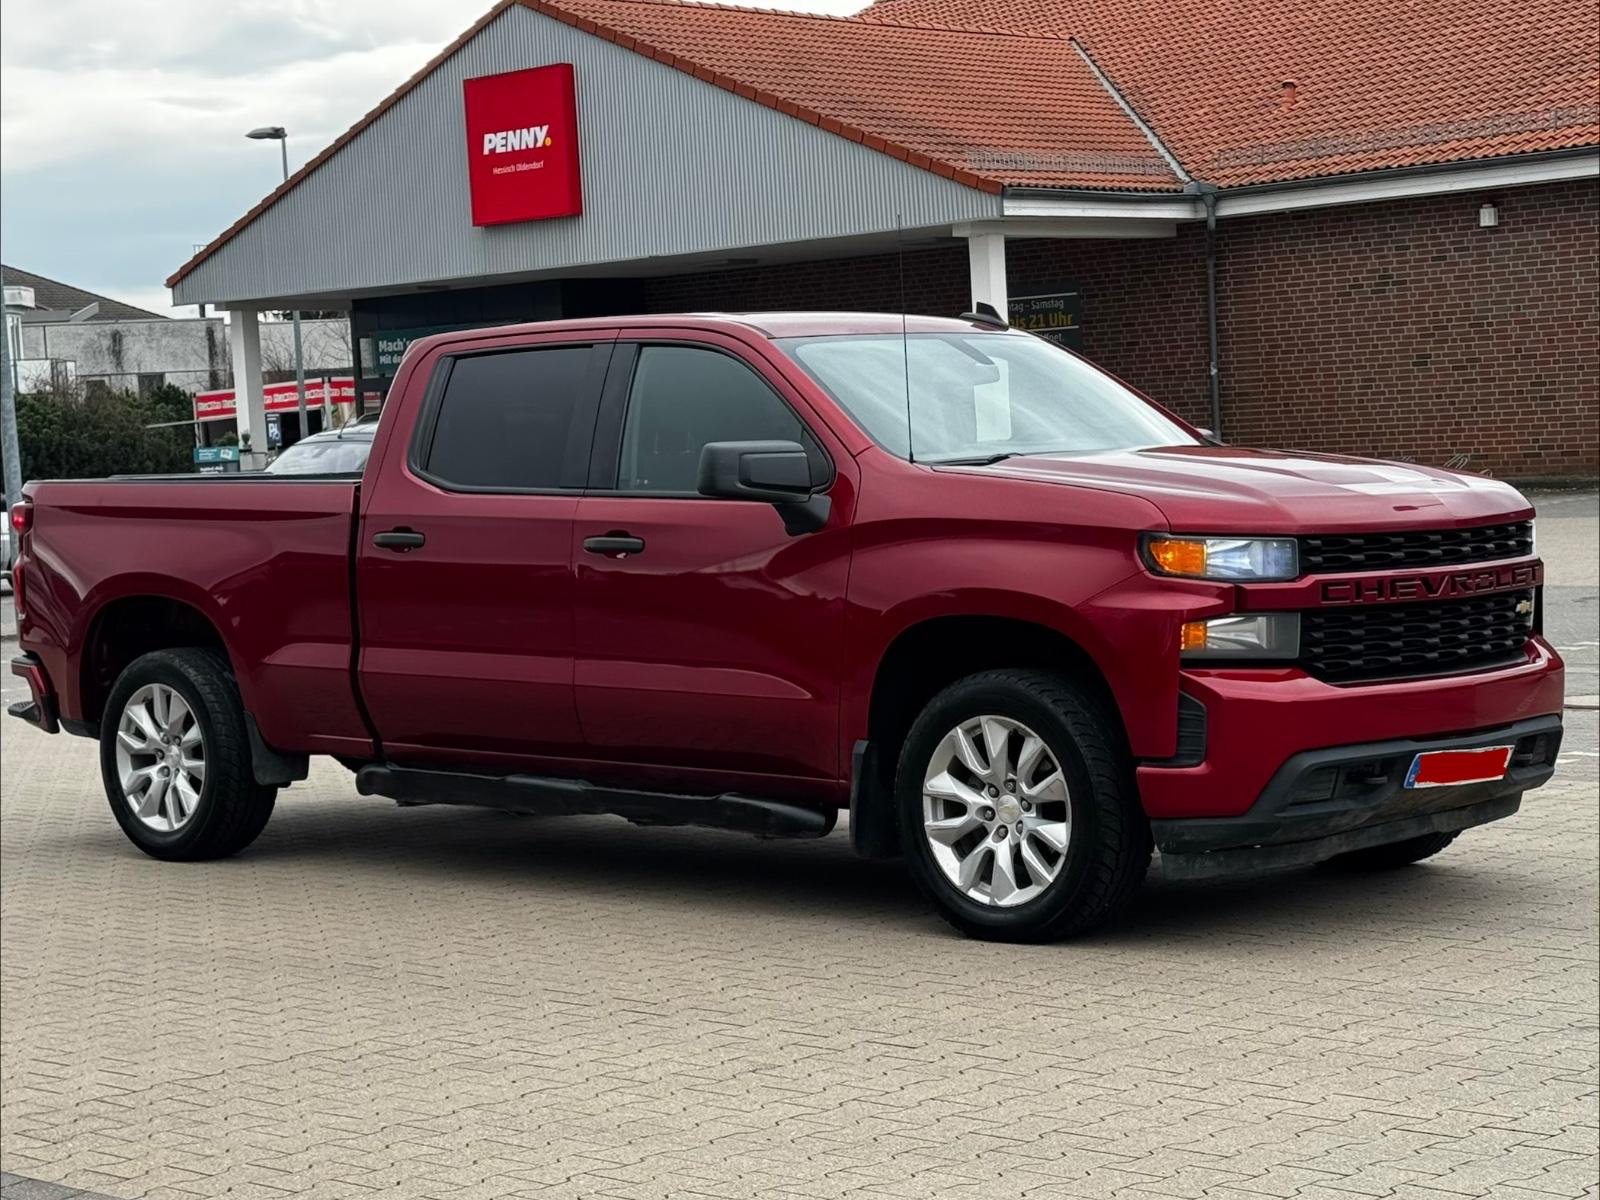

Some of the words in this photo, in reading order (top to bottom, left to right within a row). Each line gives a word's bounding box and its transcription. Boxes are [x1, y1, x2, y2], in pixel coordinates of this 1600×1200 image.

[492, 164, 516, 175] Hessisch
[516, 160, 544, 172] Oldendorf
[1008, 302, 1024, 313] ntag
[1031, 299, 1065, 310] Samstag
[1029, 314, 1046, 328] 21
[1049, 311, 1073, 327] Uhr
[380, 354, 392, 365] Mit
[392, 354, 403, 364] de
[1320, 566, 1541, 605] CHEVROLET
